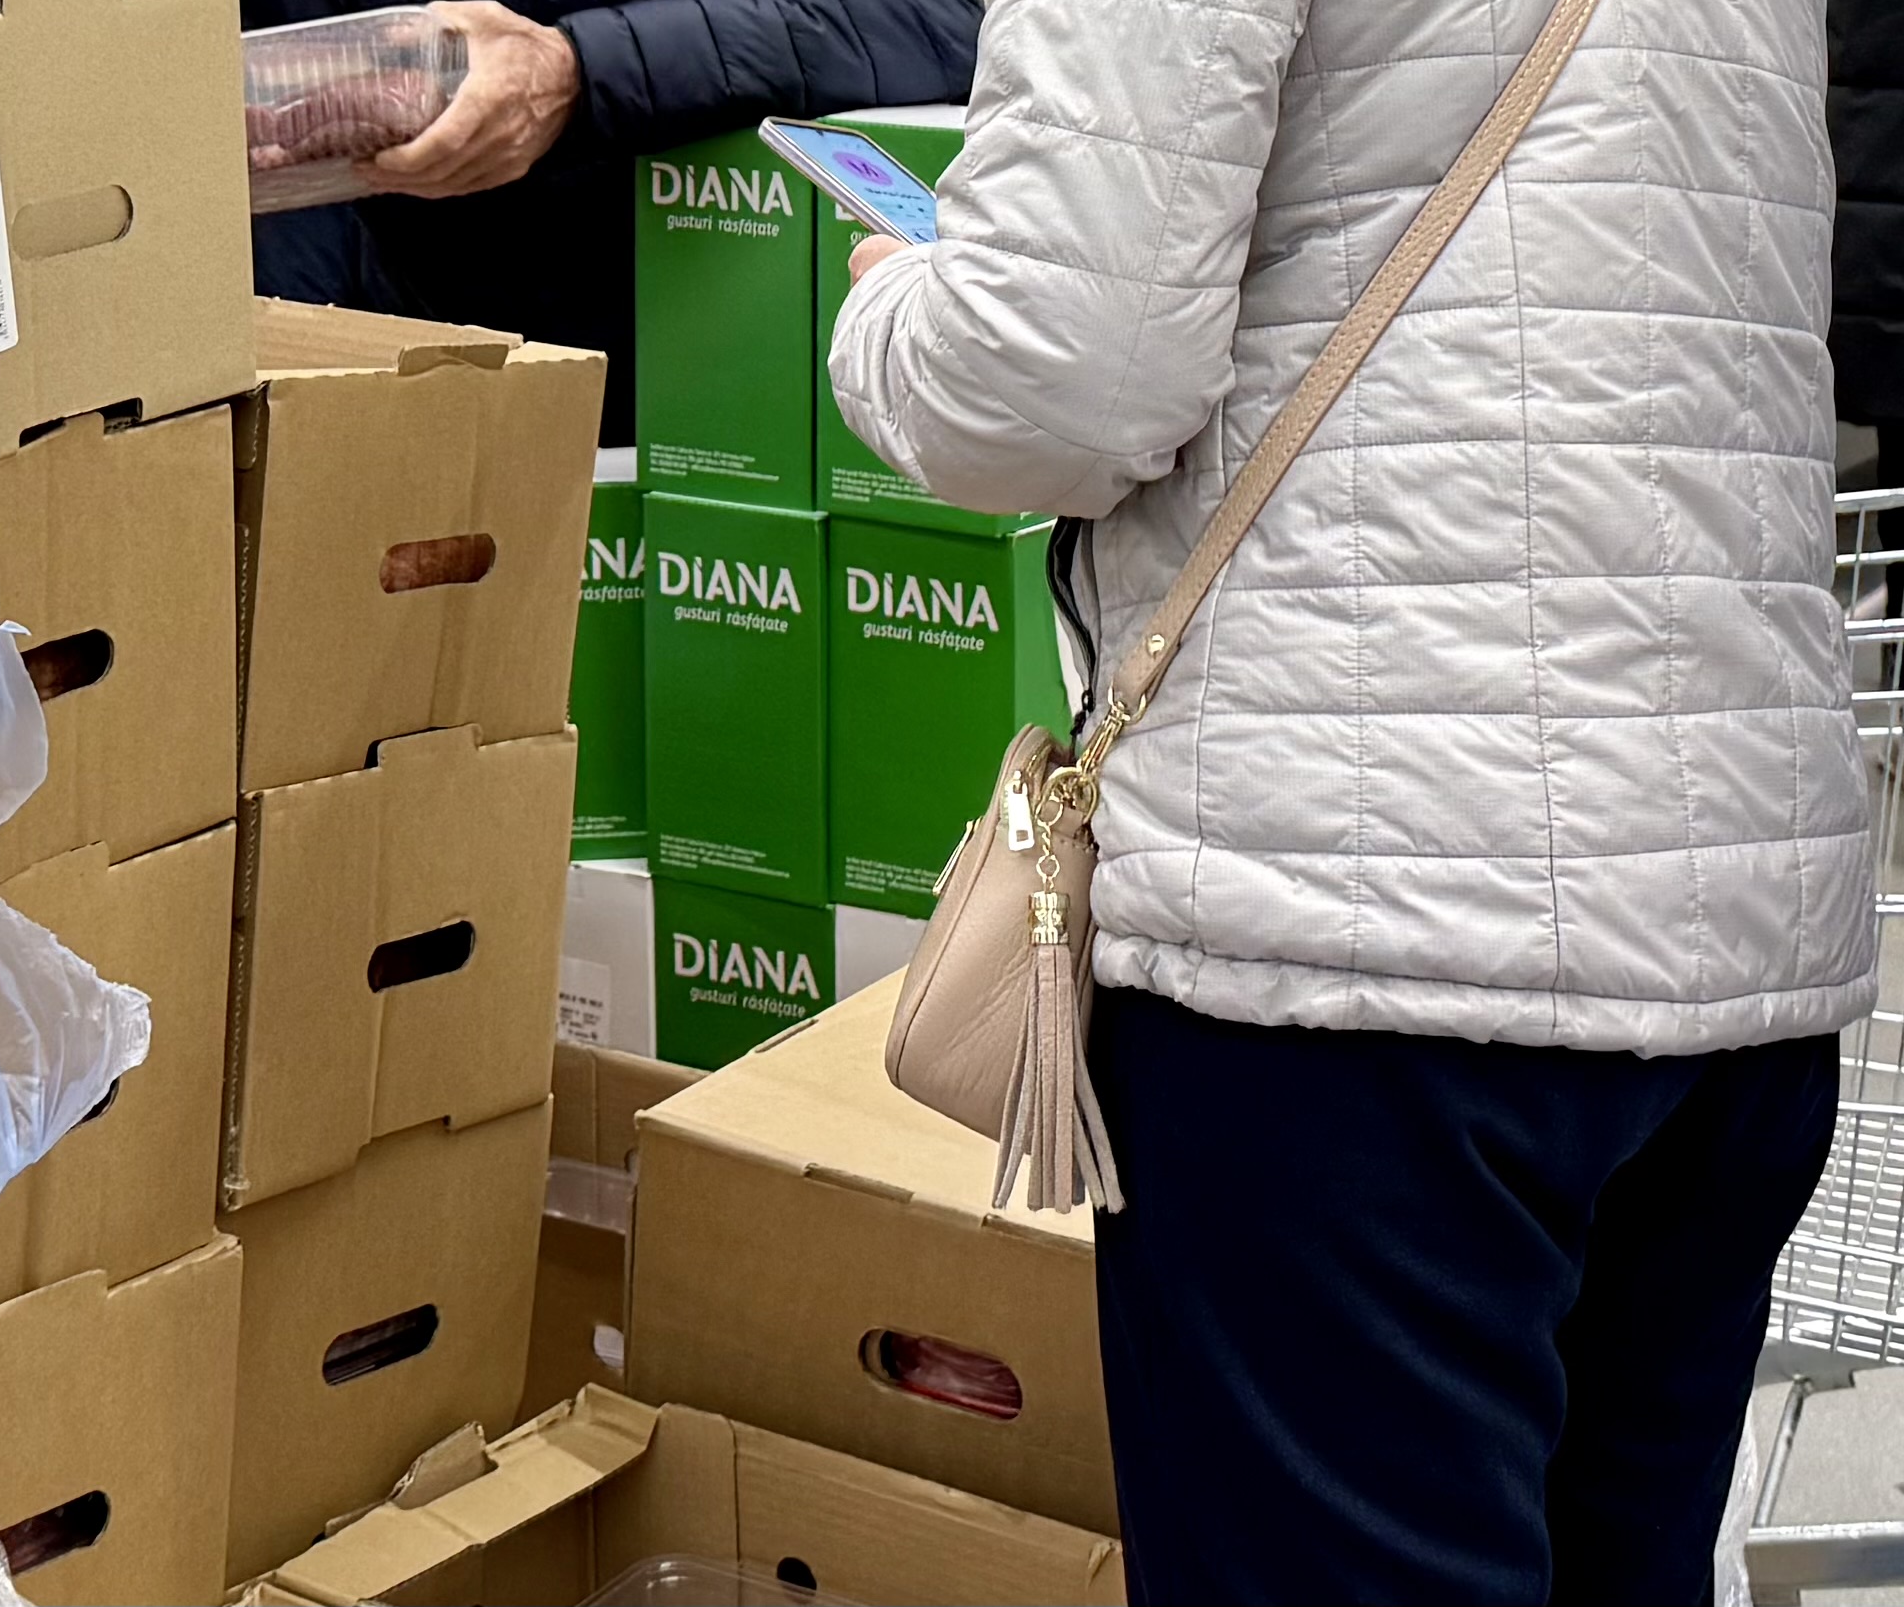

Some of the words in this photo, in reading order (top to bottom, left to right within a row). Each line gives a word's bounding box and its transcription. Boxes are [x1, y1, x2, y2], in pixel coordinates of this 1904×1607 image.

[652, 161, 793, 217] DIANA
[666, 214, 713, 233] gusturi
[657, 552, 802, 614] DIANA
[847, 567, 998, 633] DIANA
[674, 605, 721, 623] gusturi
[863, 621, 912, 642] gusturi
[673, 933, 820, 1000] DIANA
[689, 986, 737, 1010] gusturi
